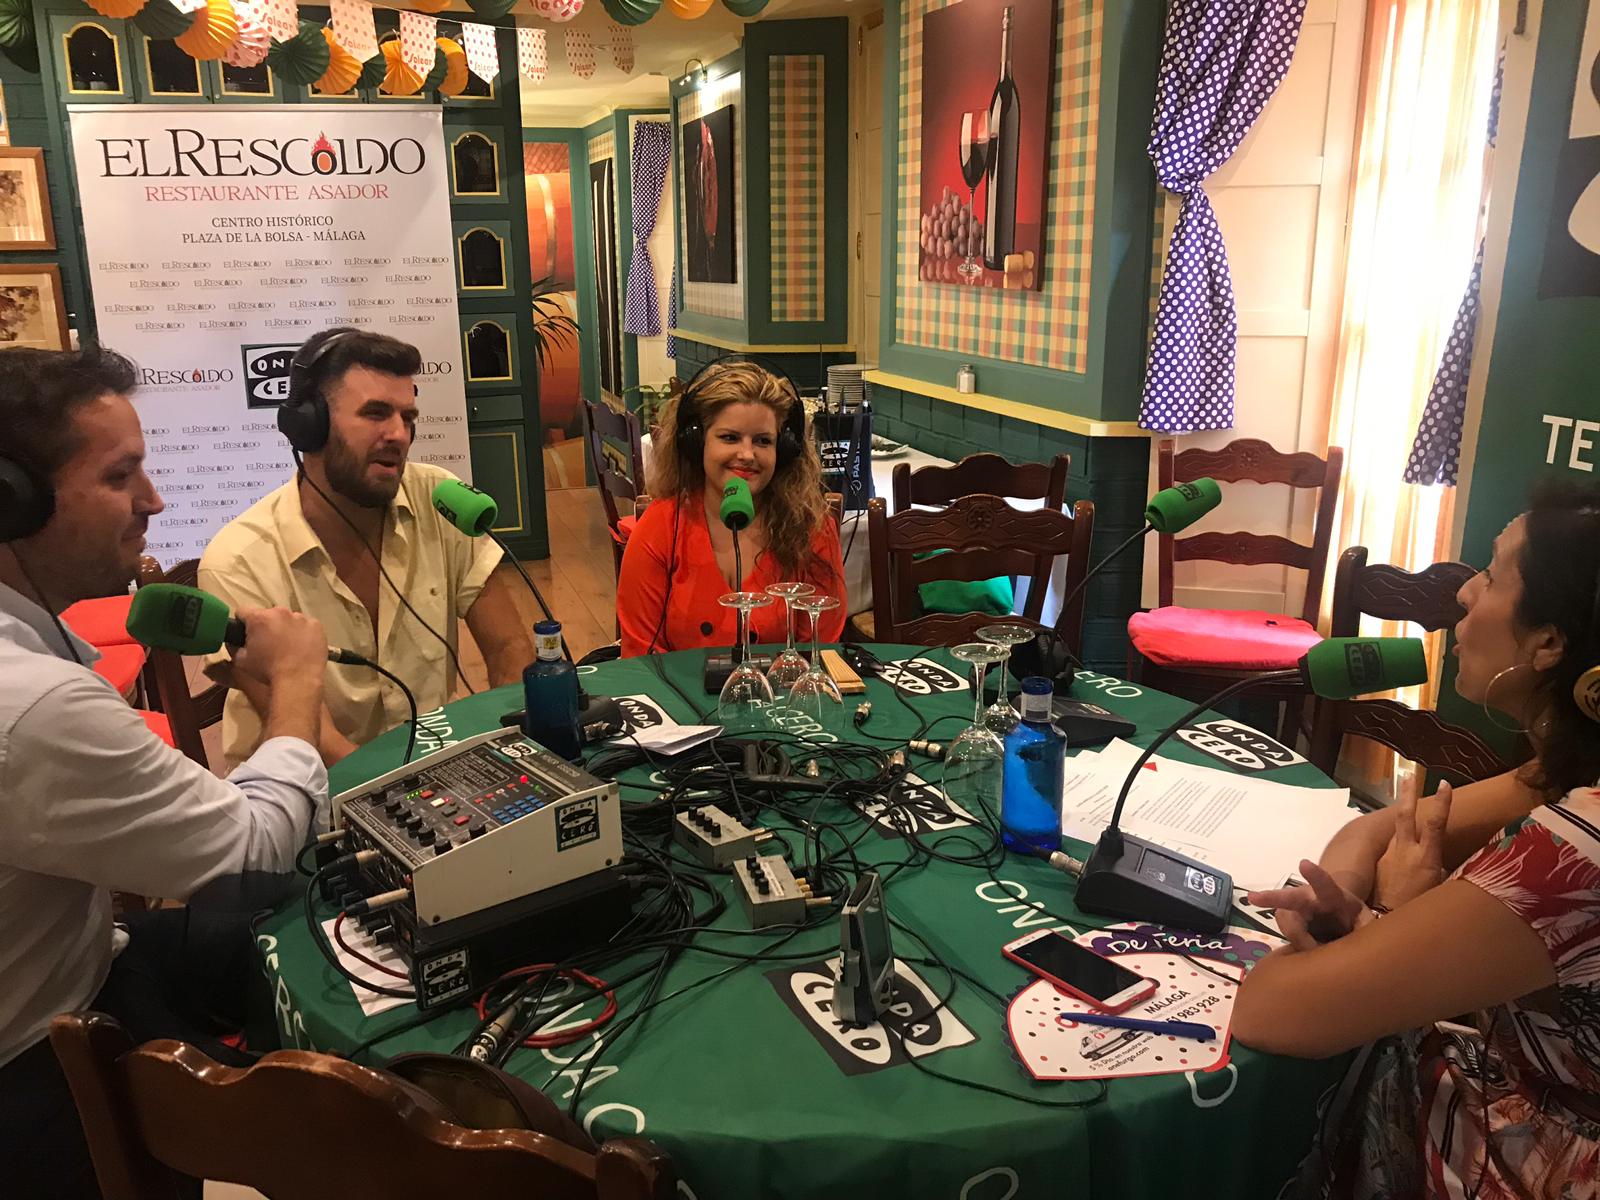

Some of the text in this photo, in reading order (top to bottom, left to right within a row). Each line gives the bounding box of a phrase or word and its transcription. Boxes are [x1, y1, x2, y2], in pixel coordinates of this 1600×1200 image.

[145, 183, 389, 201] RESTAURANTE ASADOR
[211, 213, 334, 228] CENTRO HISTÓRICO
[182, 233, 221, 243] PLAZA
[225, 232, 242, 243] DE
[246, 232, 262, 242] LA
[265, 231, 303, 243] BOLSA
[313, 229, 366, 241] MÁLAGA
[257, 358, 296, 372] ON
[1542, 414, 1600, 472] TE
[907, 663, 953, 687] ONDA
[619, 700, 656, 727] ONDA
[1188, 732, 1256, 765] CERO
[1216, 725, 1285, 759] ONDA
[562, 800, 593, 815] ONDA
[561, 822, 594, 839] CERO
[1106, 938, 1148, 954] De
[427, 952, 462, 970] ONDA
[428, 976, 464, 996] CERO
[1143, 989, 1192, 1015] MÁLAGA
[1177, 1006, 1200, 1019] 983
[1199, 995, 1220, 1010] 928
